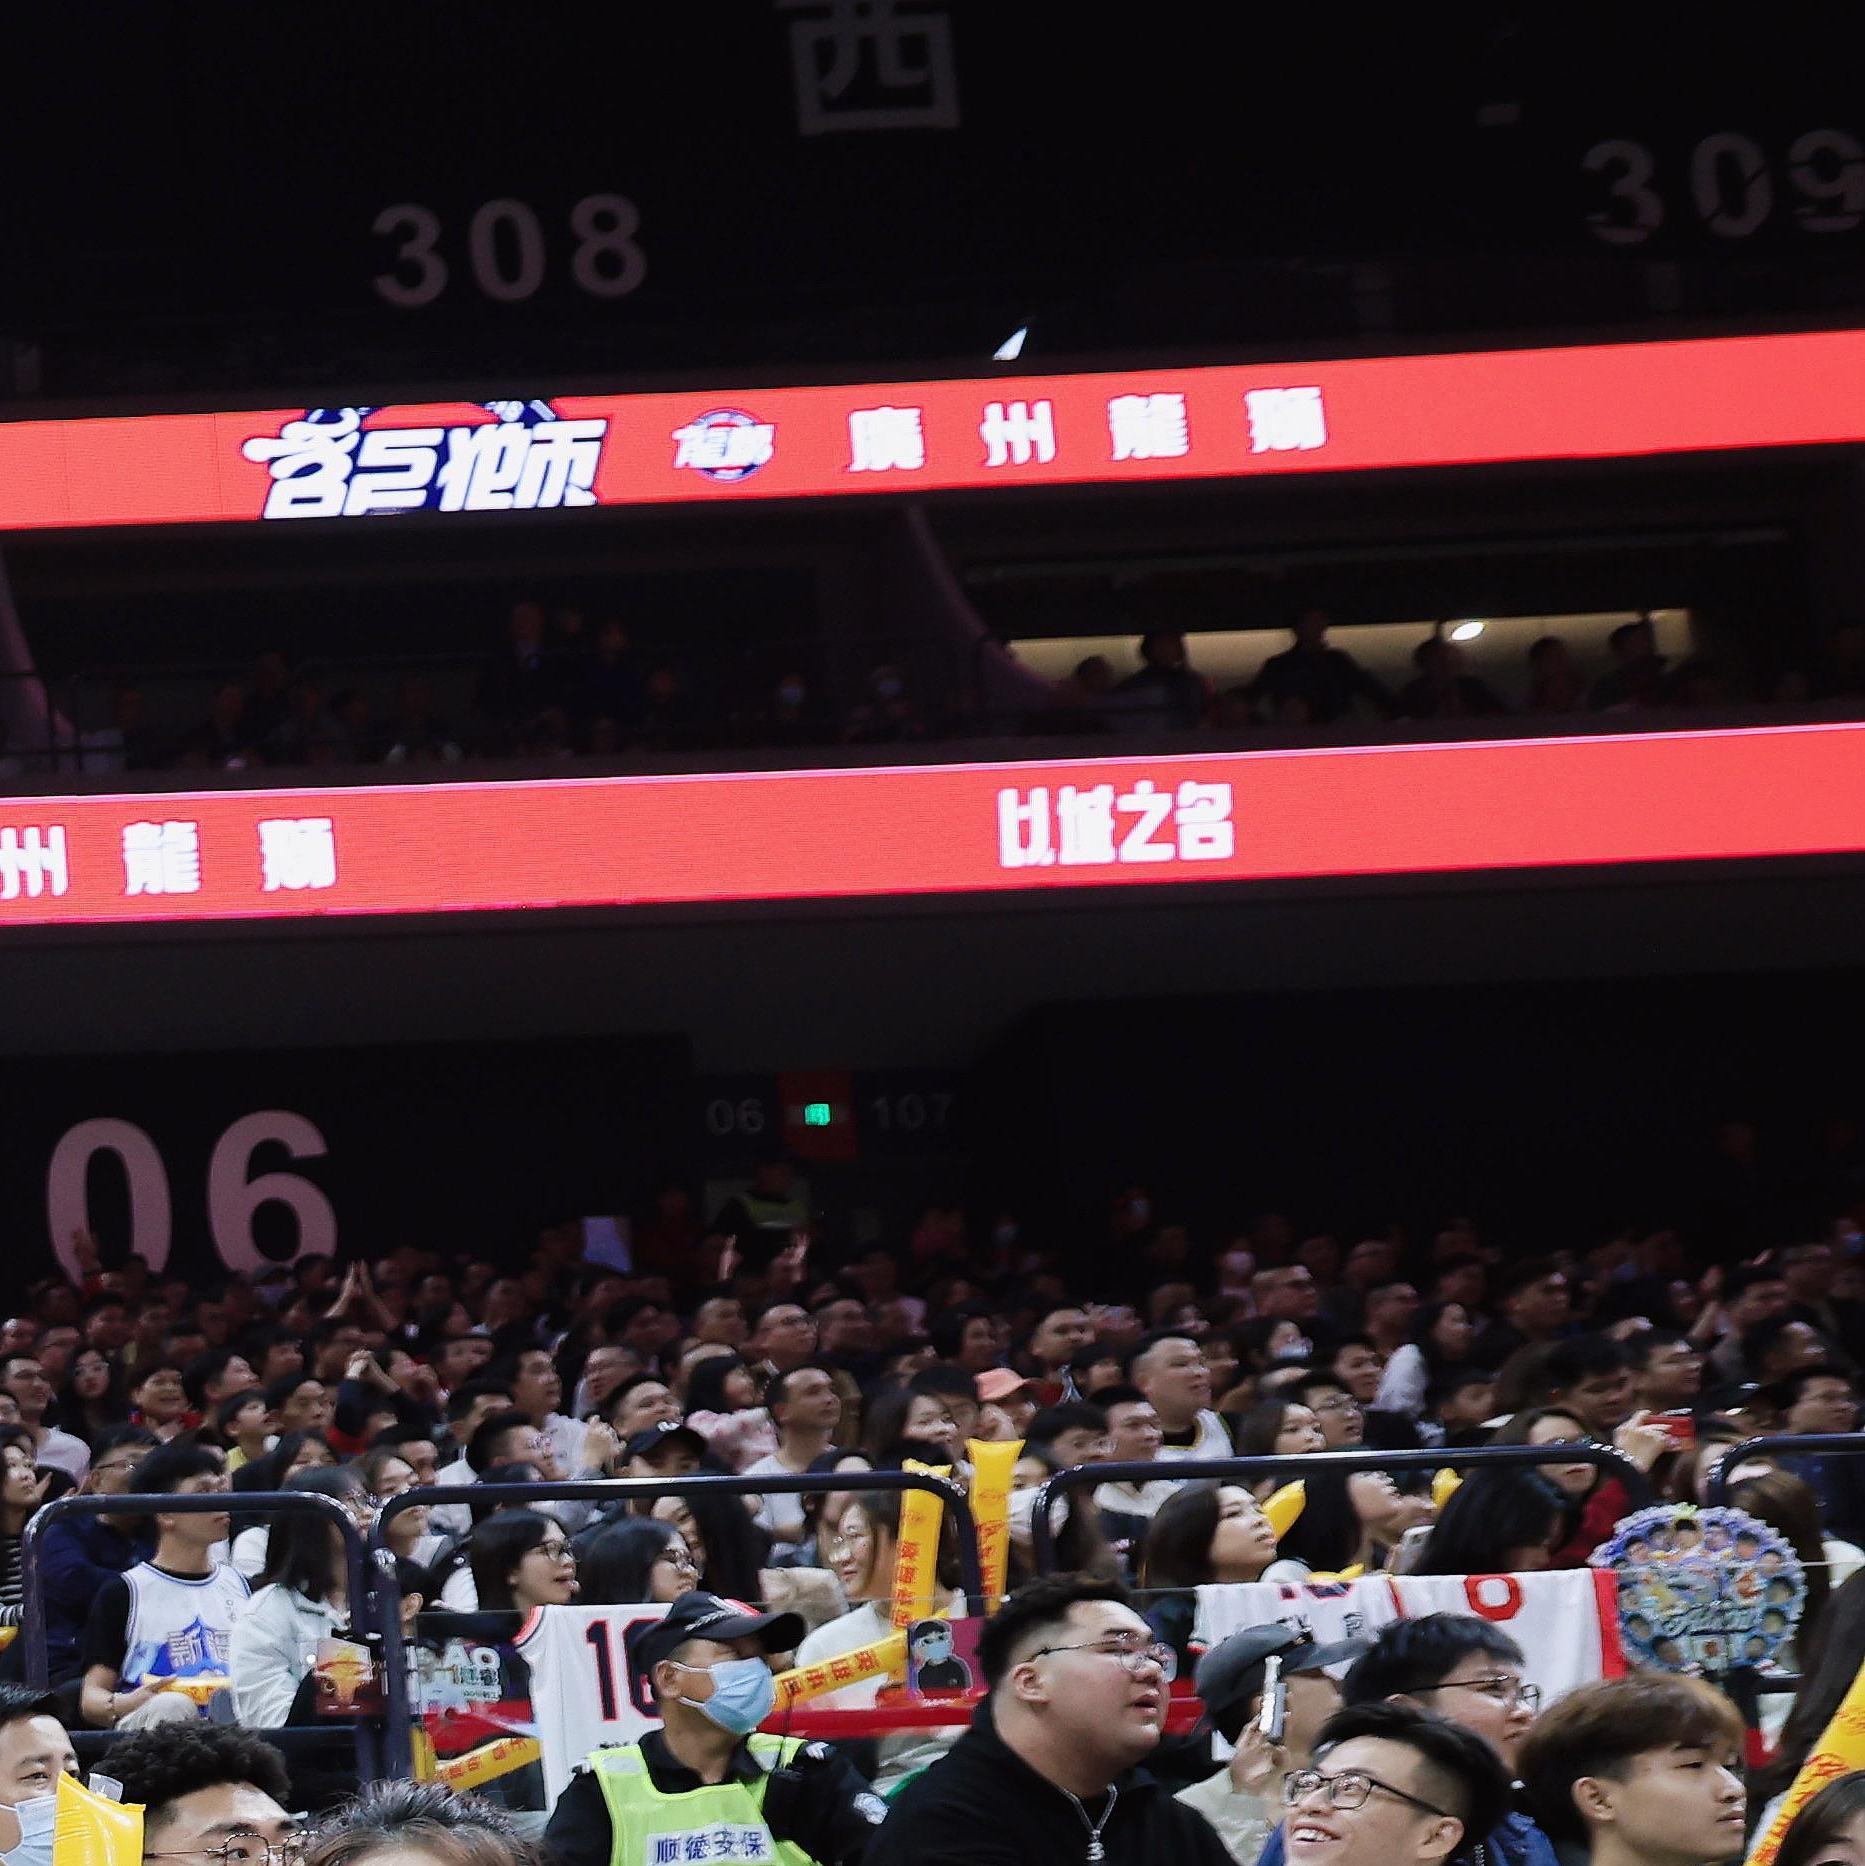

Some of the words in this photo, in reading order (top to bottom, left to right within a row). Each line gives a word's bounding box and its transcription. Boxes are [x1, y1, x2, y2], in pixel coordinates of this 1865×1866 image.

[1581, 128, 1865, 248] 309
[370, 194, 649, 308] 308
[998, 780, 1236, 868] 以城之名
[704, 1099, 766, 1136] 06
[872, 1093, 953, 1130] 107
